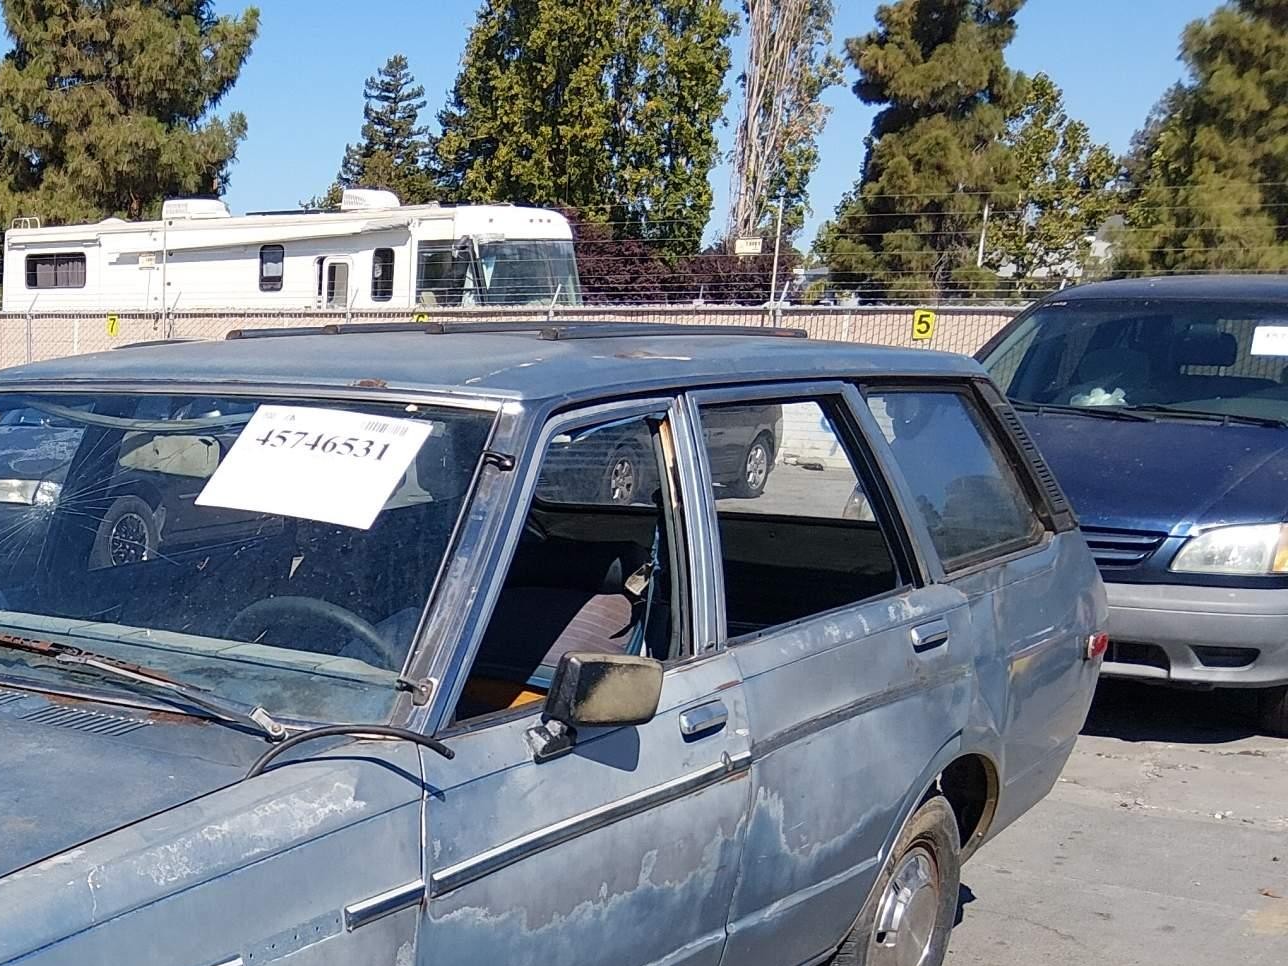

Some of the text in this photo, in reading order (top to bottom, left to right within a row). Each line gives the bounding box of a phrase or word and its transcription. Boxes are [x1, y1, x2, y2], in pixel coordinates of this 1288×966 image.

[109, 318, 116, 333] 7
[916, 314, 931, 334] 5
[256, 428, 390, 461] 45746531
